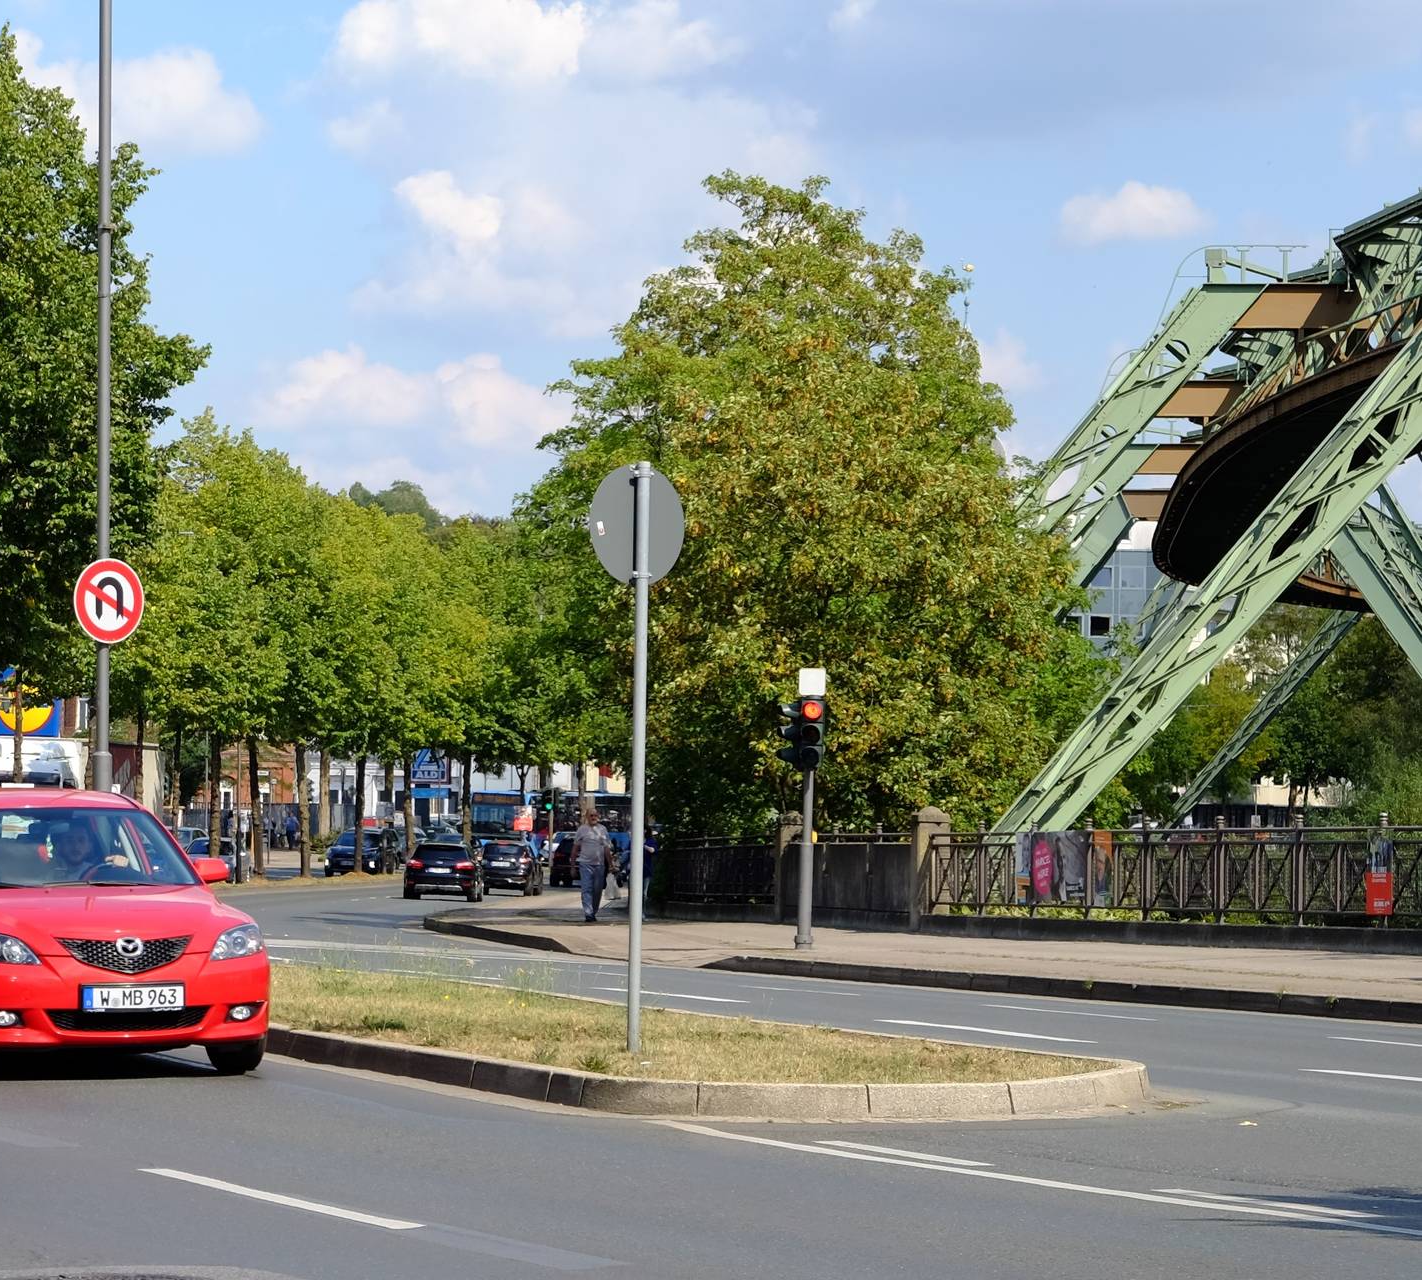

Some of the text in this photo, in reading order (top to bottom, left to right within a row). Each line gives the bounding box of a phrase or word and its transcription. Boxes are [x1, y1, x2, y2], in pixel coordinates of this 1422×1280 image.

[415, 770, 442, 779] ALD
[100, 990, 110, 1006] W
[122, 989, 143, 1006] MB
[148, 988, 177, 1006] 963
